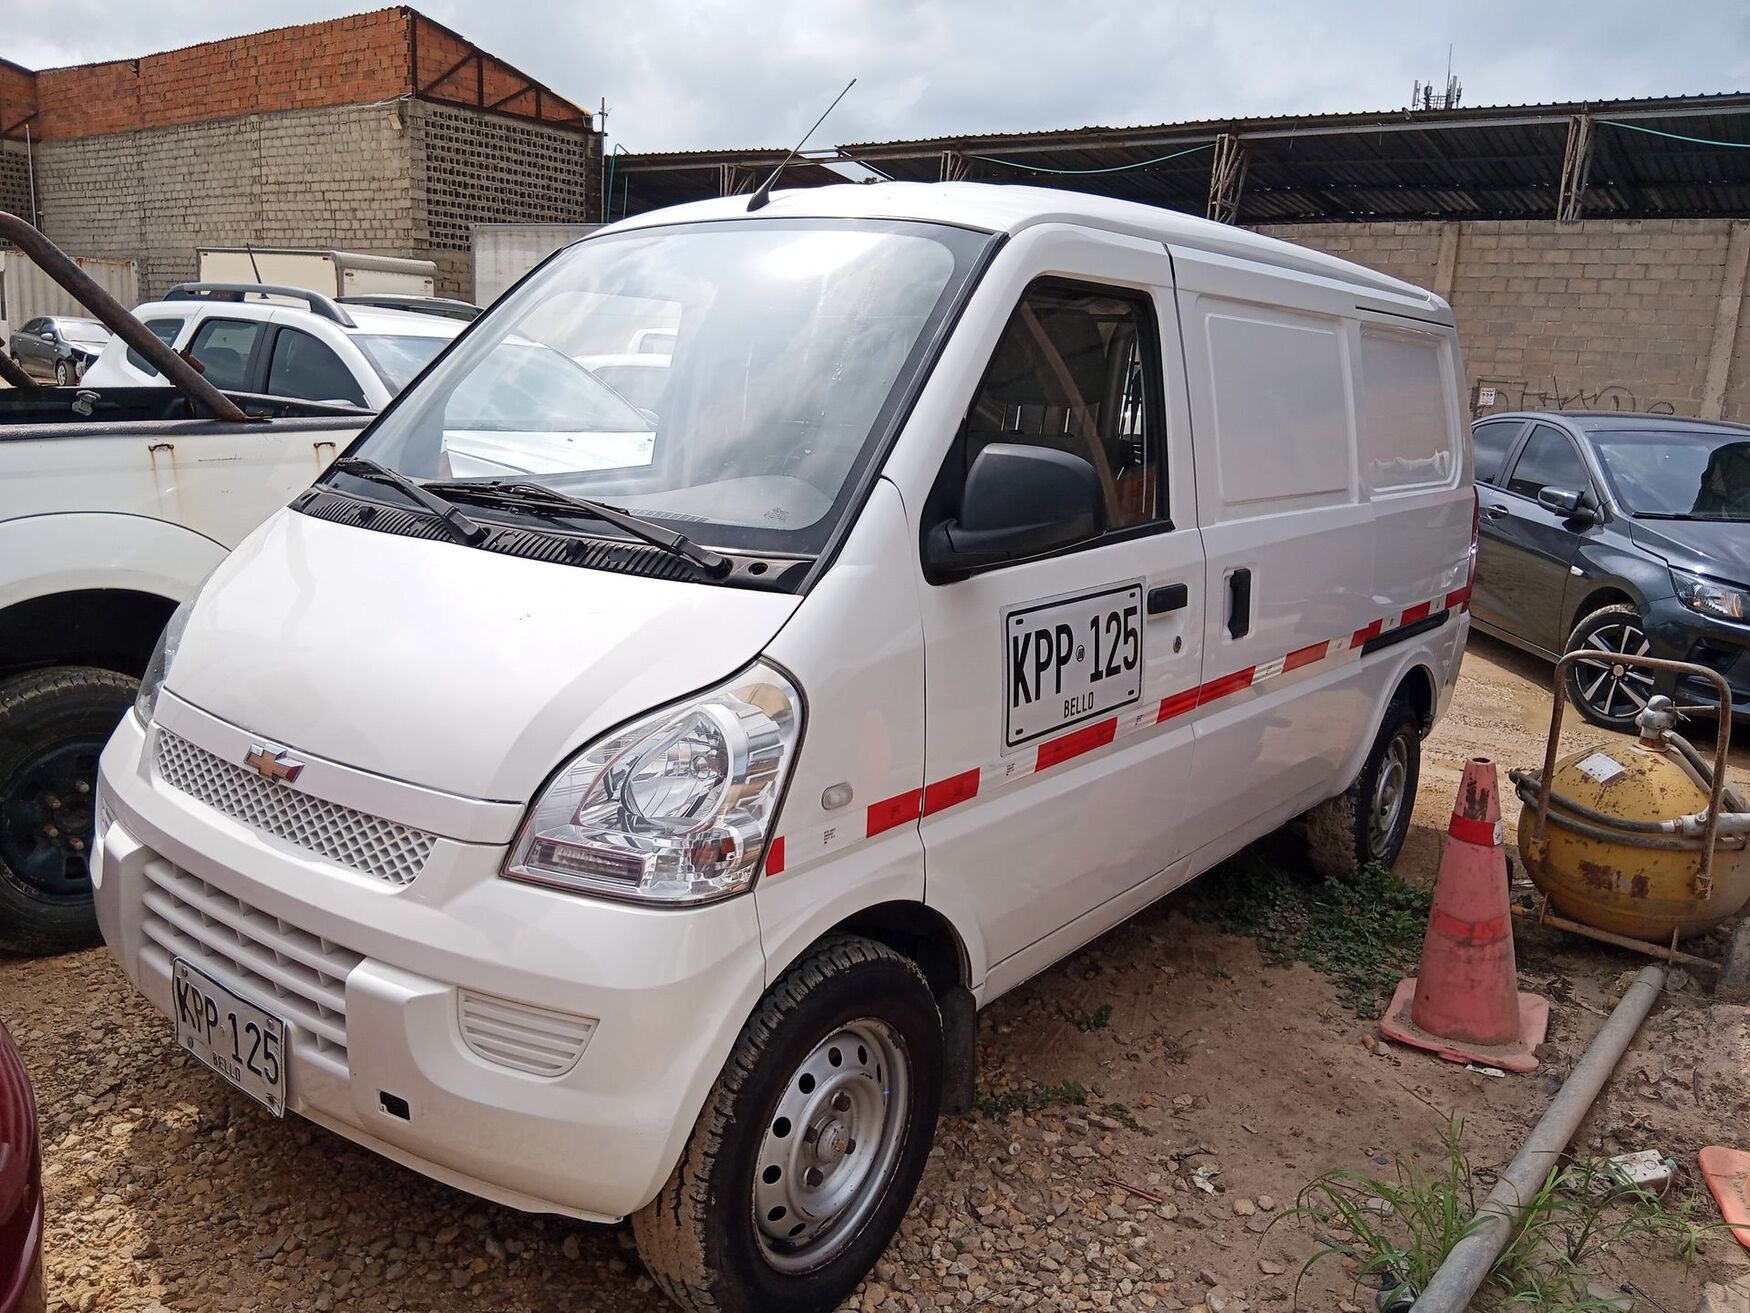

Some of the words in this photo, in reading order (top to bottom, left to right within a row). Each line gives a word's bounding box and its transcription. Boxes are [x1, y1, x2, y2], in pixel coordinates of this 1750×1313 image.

[1012, 623, 1074, 708] KPP
[1090, 606, 1139, 683] 125
[1063, 691, 1094, 719] BELLO
[176, 976, 219, 1046] KPP
[228, 1012, 279, 1085] 125
[212, 1051, 241, 1083] BELLO
